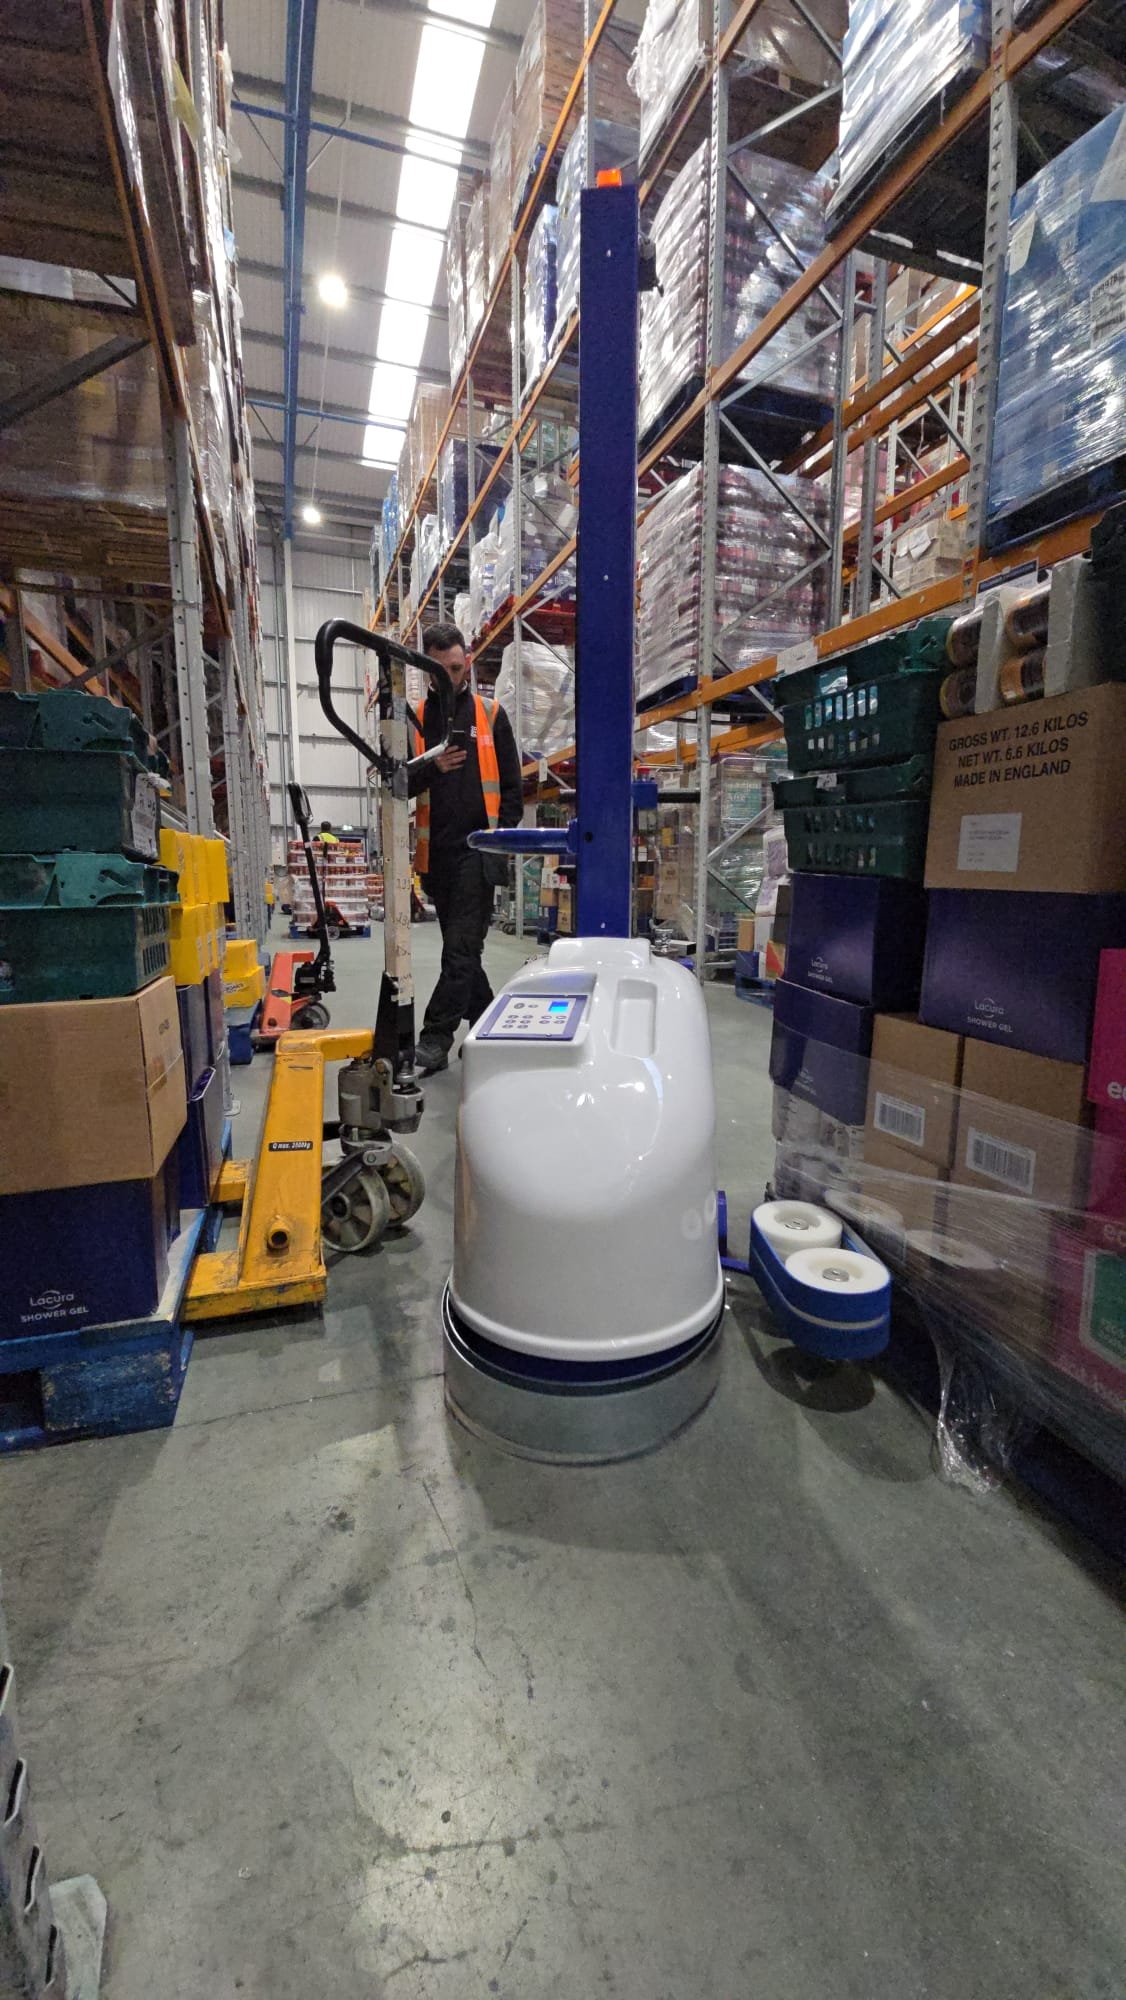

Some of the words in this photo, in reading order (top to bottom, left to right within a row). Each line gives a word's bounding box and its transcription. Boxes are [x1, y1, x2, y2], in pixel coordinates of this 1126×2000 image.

[949, 733, 988, 751] GROSS
[990, 728, 1010, 742] WT.
[1015, 722, 1039, 738] 12.6
[1043, 711, 1088, 733] KILOS
[958, 753, 979, 768] NET
[982, 750, 1002, 764] WT.
[1026, 737, 1069, 757] KILOS
[954, 772, 986, 788] MADE
[989, 769, 1000, 783] IN
[1004, 760, 1071, 781] ENGLAND
[974, 999, 1004, 1016] Lacura
[967, 1016, 998, 1029] SHOWER
[998, 1023, 1013, 1032] GEL
[29, 1291, 75, 1309] Lacura
[20, 1309, 67, 1323] SHOWER
[69, 1306, 89, 1315] GEL
